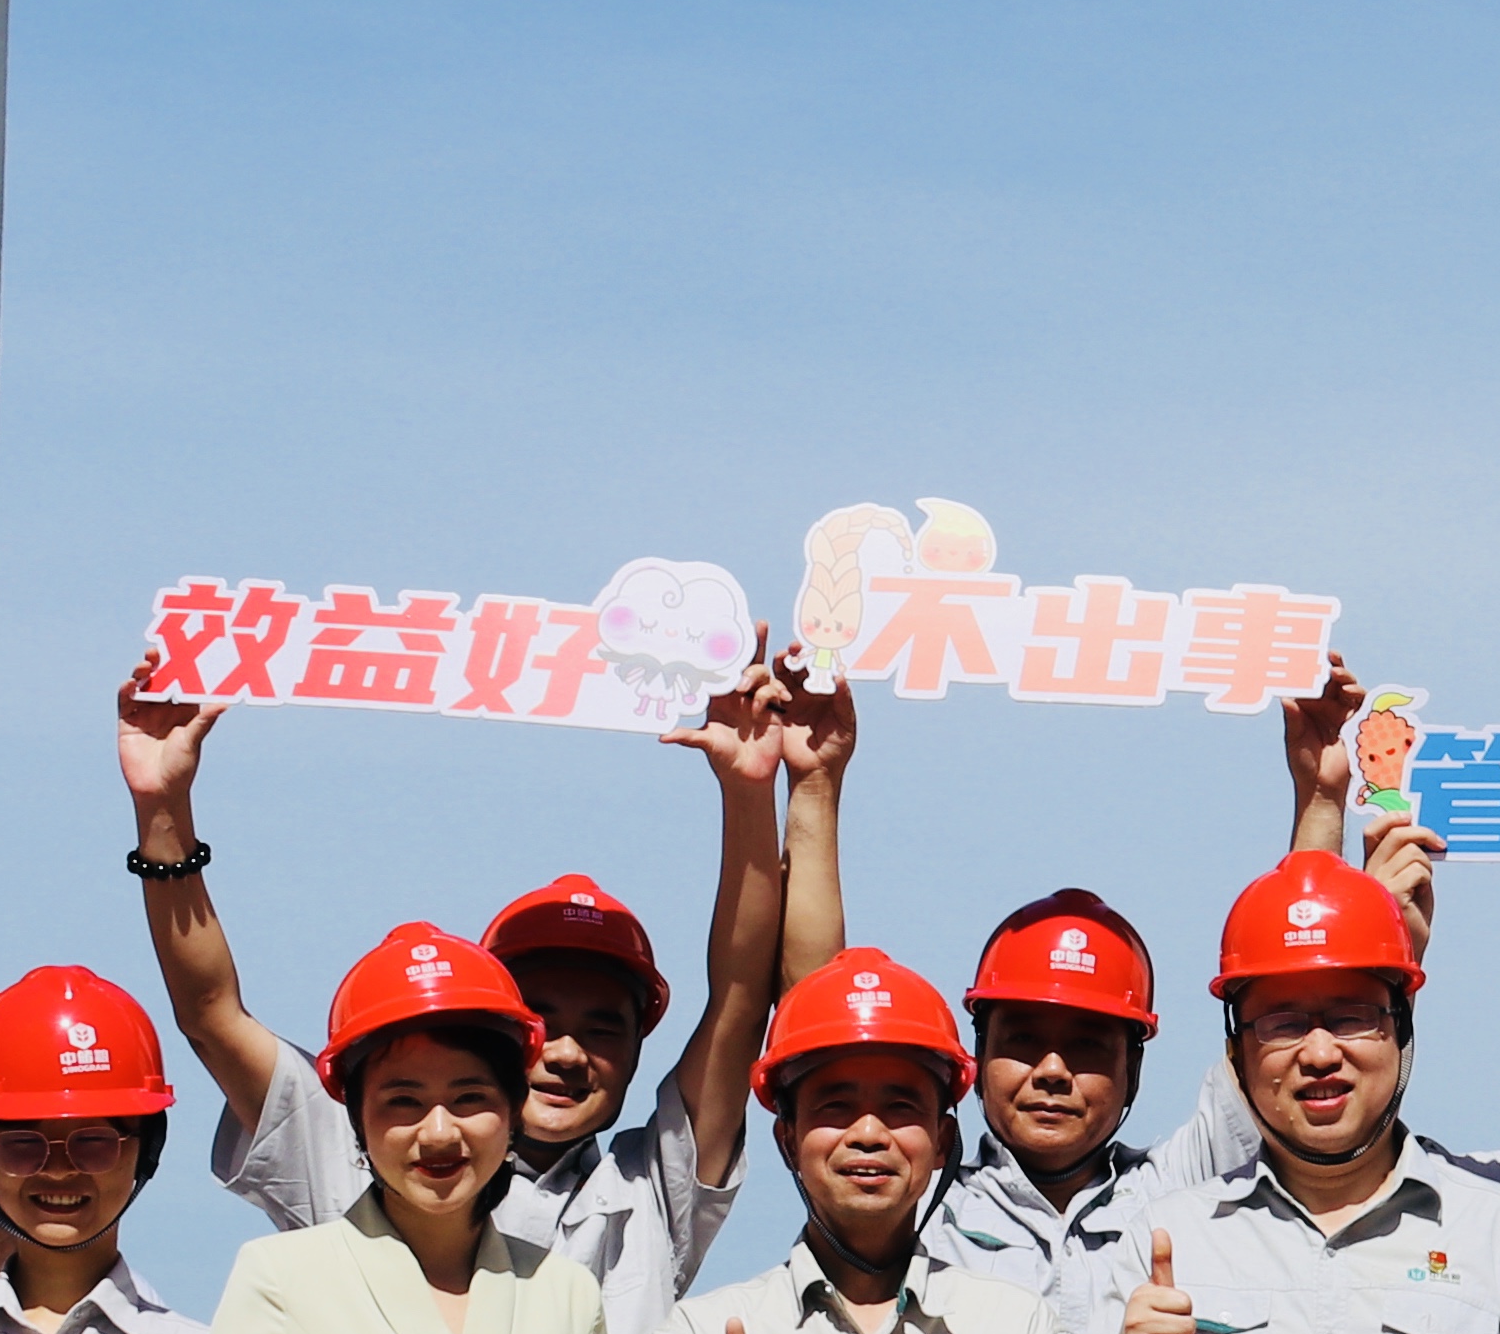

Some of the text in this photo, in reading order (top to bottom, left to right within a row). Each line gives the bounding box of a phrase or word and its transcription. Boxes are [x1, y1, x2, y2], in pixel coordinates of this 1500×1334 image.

[137, 582, 610, 721] 效益好
[852, 574, 1331, 699] 不出事
